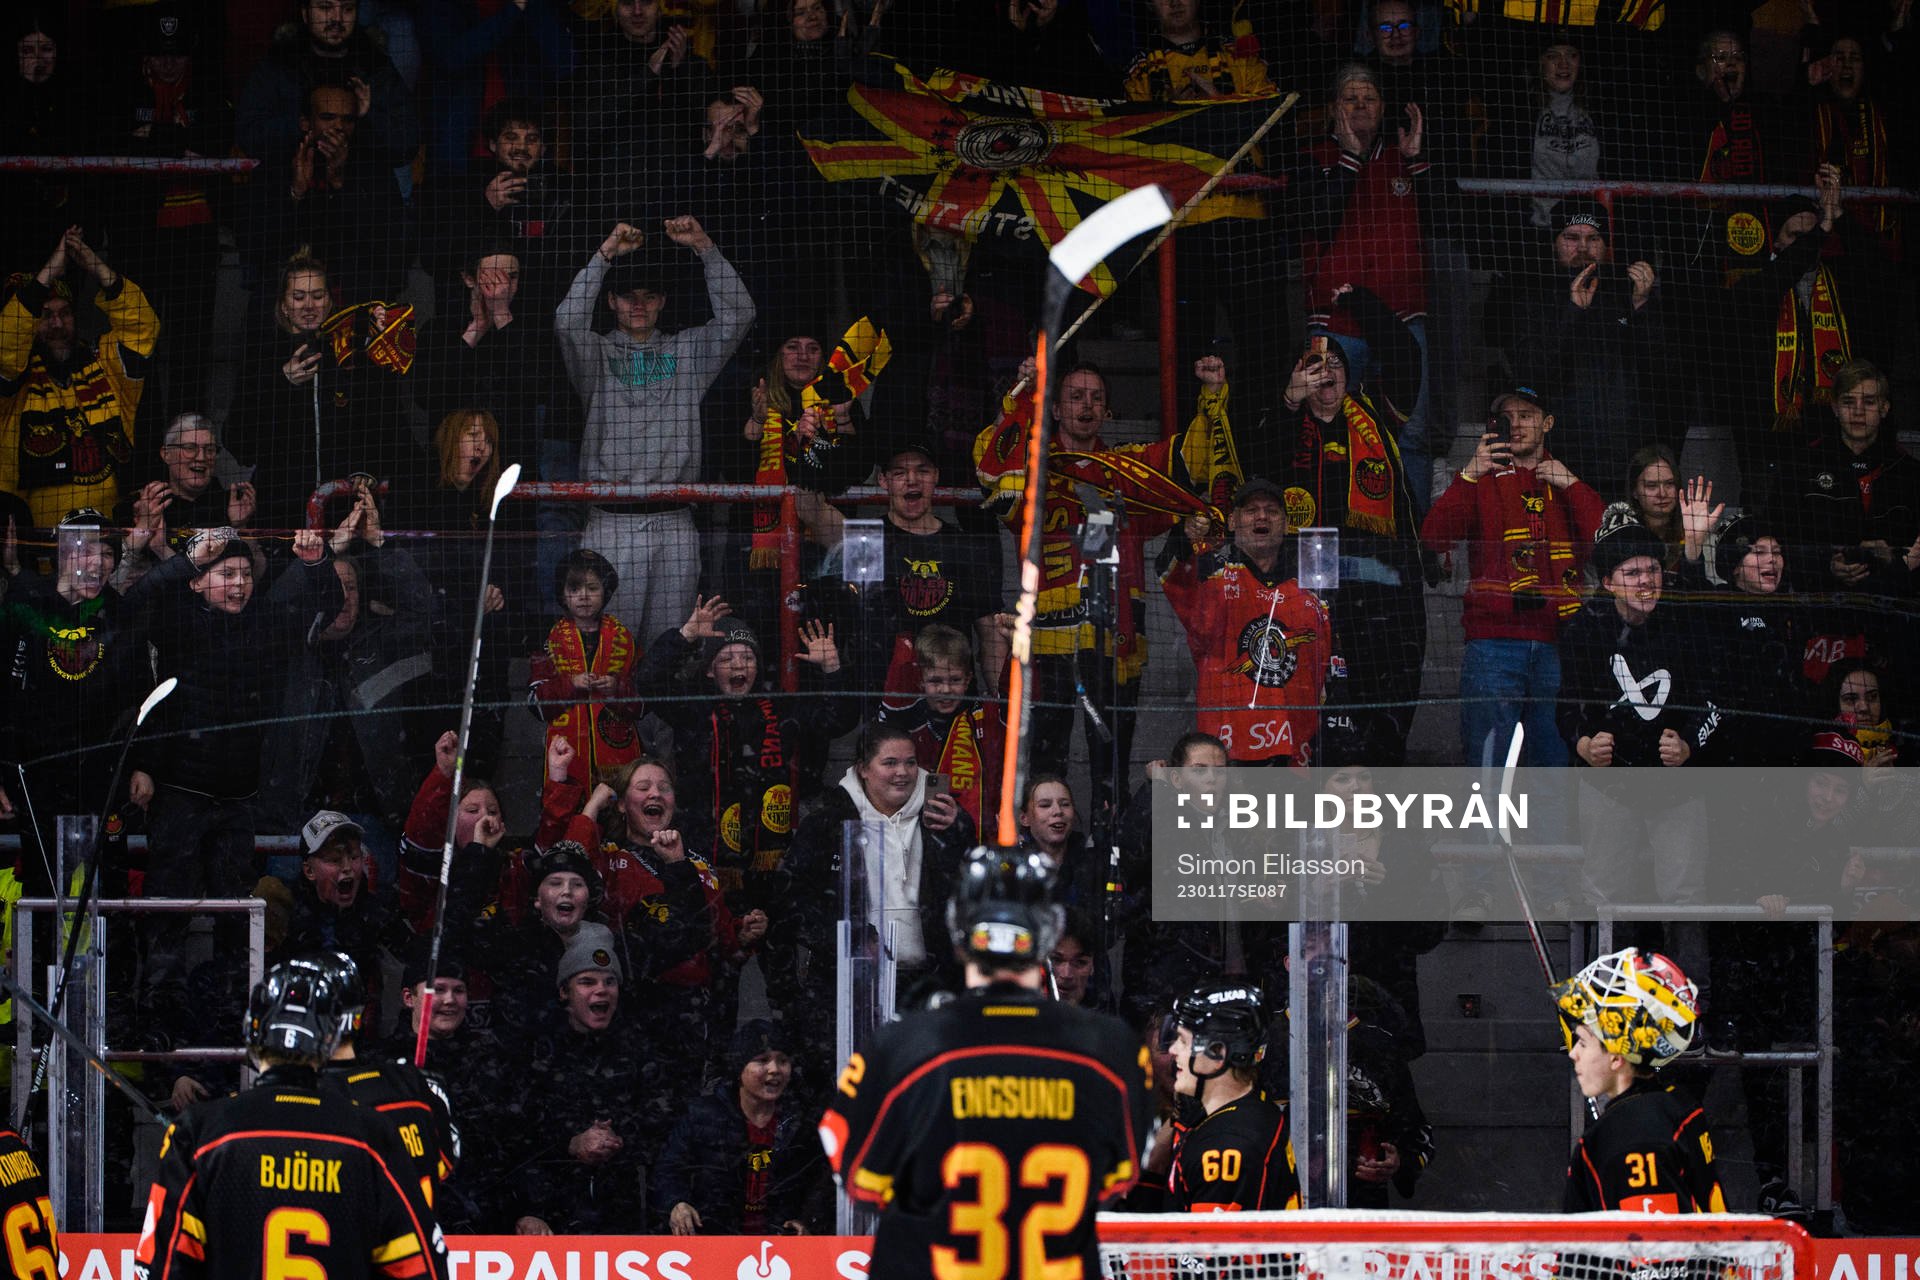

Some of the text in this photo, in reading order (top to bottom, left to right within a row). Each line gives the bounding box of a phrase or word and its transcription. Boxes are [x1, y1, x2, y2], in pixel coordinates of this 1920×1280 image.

[950, 1075, 1076, 1121] ENGSUND
[259, 1150, 344, 1194] BJÖRK
[1201, 1148, 1242, 1183] 60
[1624, 1151, 1660, 1189] 31
[929, 1141, 1092, 1280] 32
[262, 1205, 332, 1280] 6
